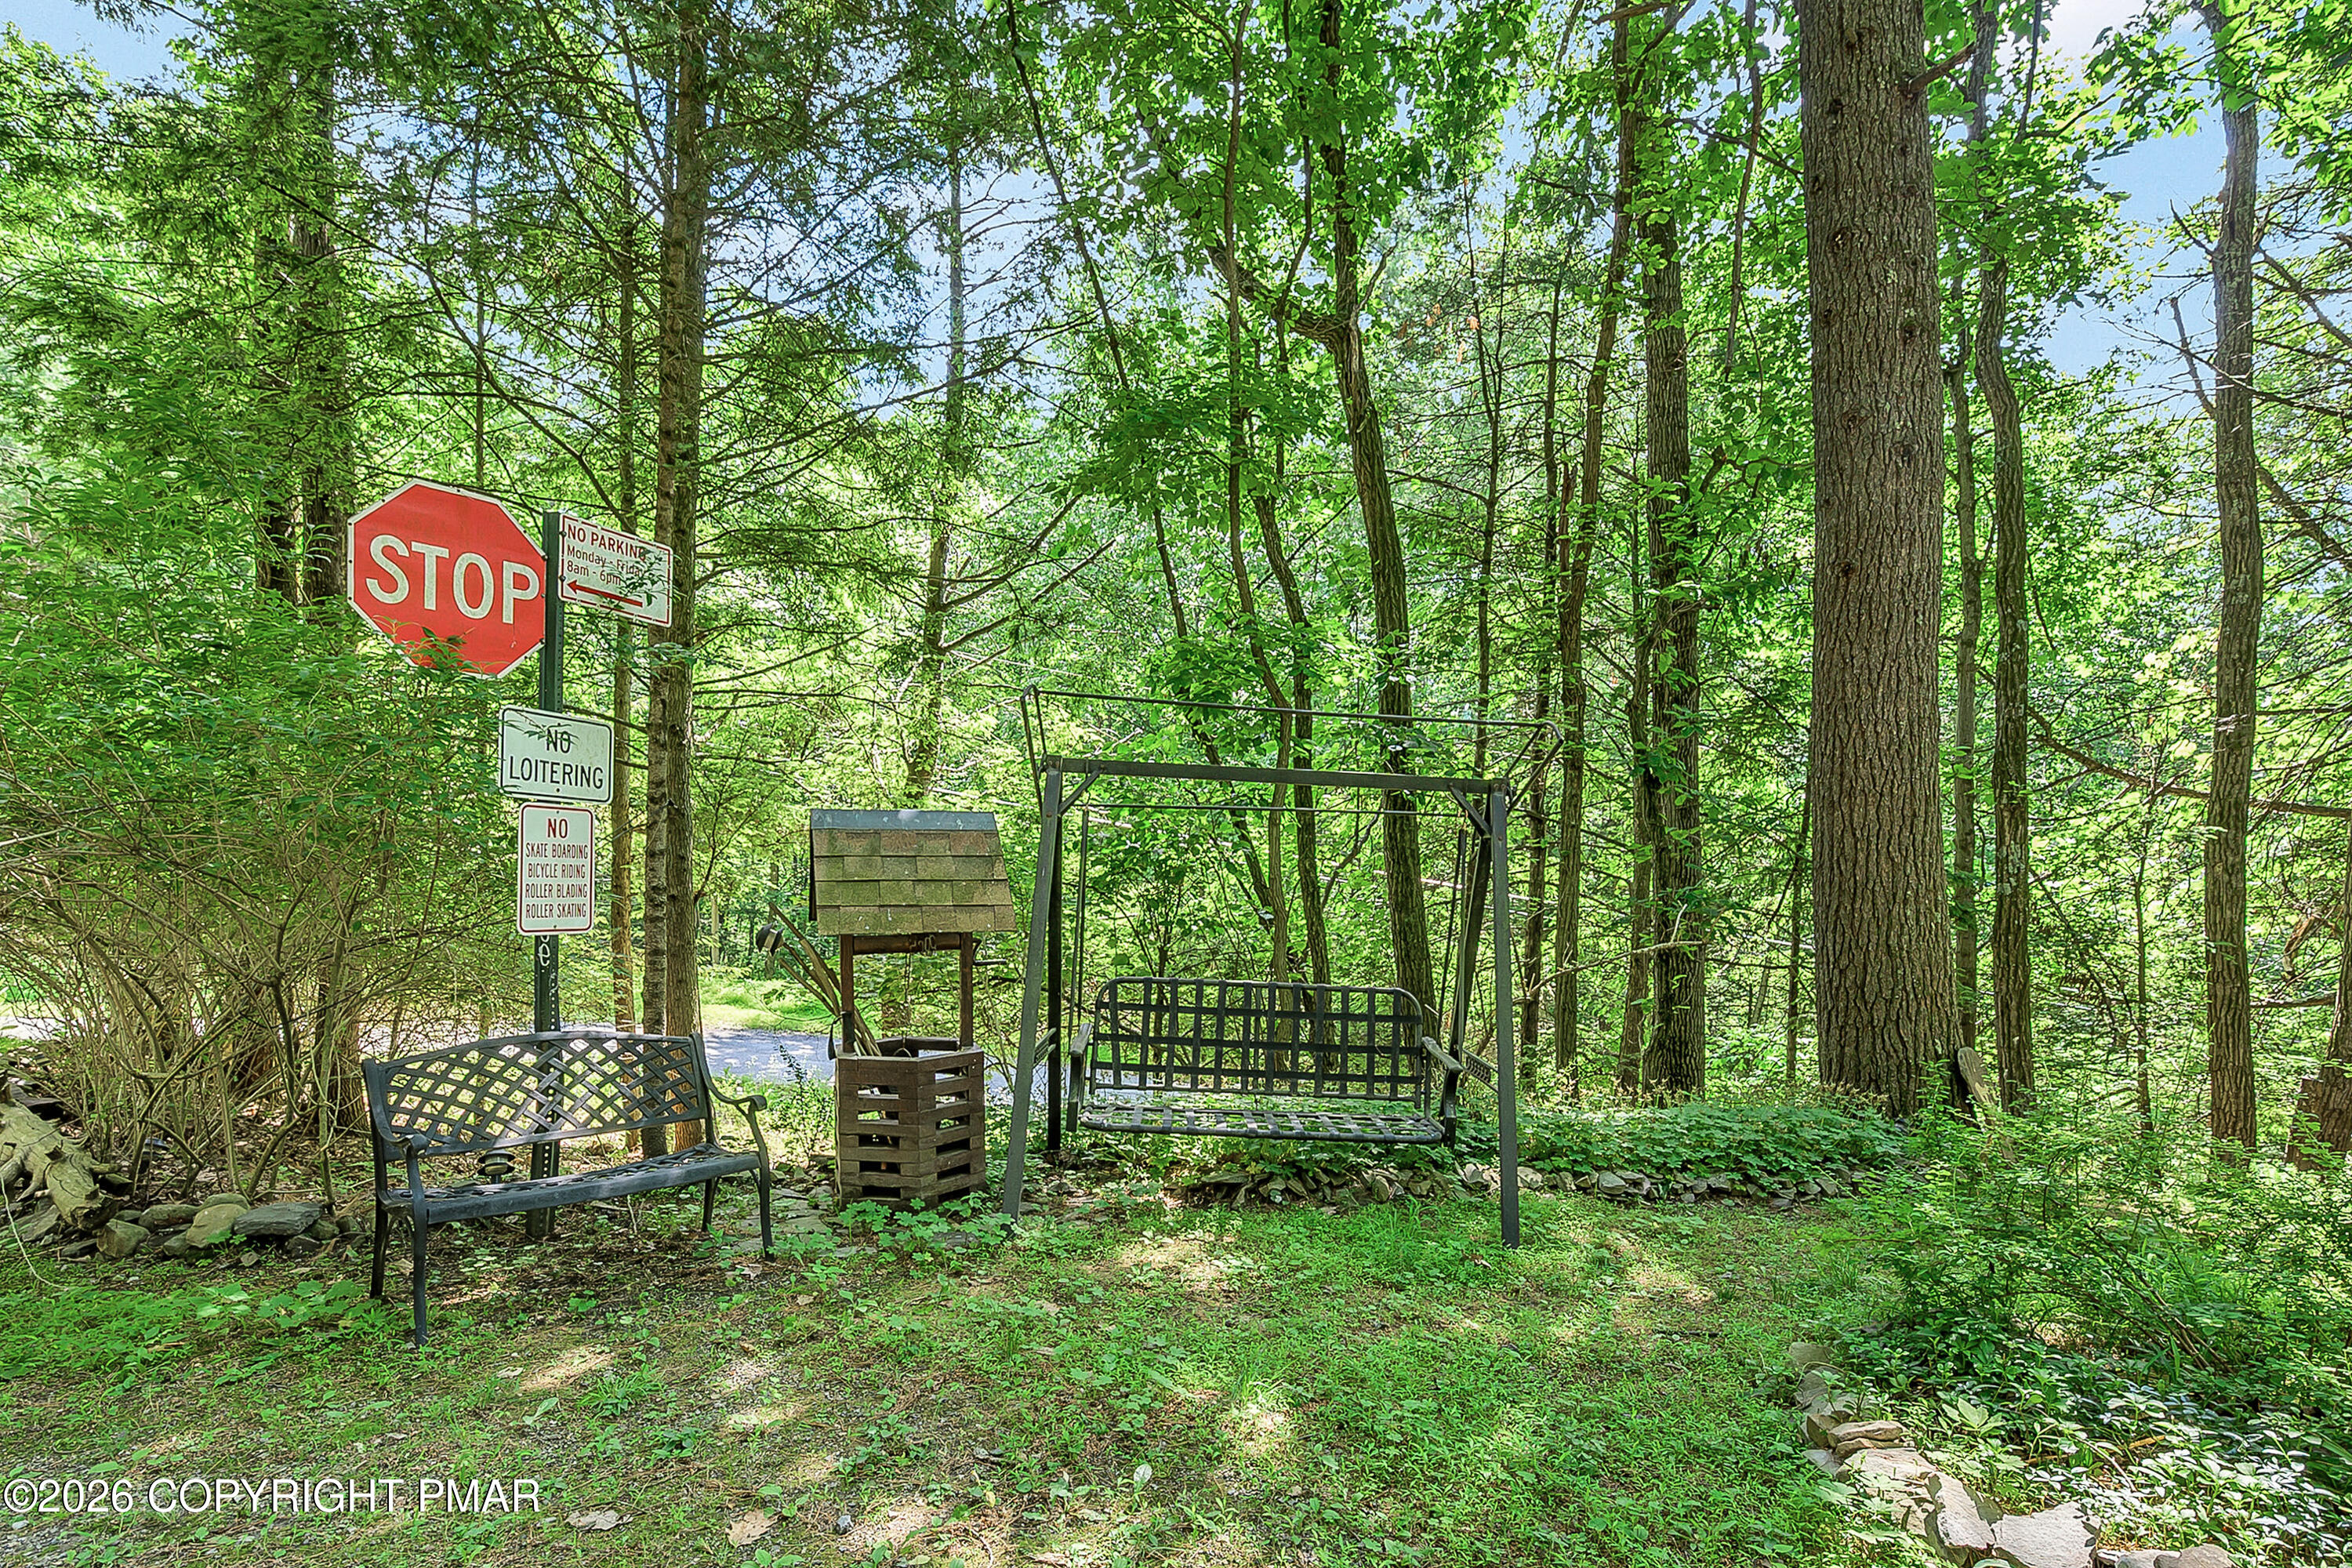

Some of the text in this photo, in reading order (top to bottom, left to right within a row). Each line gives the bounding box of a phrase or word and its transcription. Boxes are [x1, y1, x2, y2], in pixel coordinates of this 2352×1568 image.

[568, 524, 646, 562] NO PARKING
[567, 544, 607, 568] Monday
[365, 534, 540, 625] STOP
[567, 560, 590, 577] 8am
[600, 570, 621, 586] 6pm
[546, 729, 572, 753] NO
[510, 756, 604, 789] LOITERING
[547, 818, 568, 839] NO
[525, 842, 589, 860] SKATE BOARDING
[528, 863, 586, 879] BICYCLE RIDING
[525, 883, 588, 898] ROLLER BLADING
[525, 903, 586, 919] ROLLER SKATING
